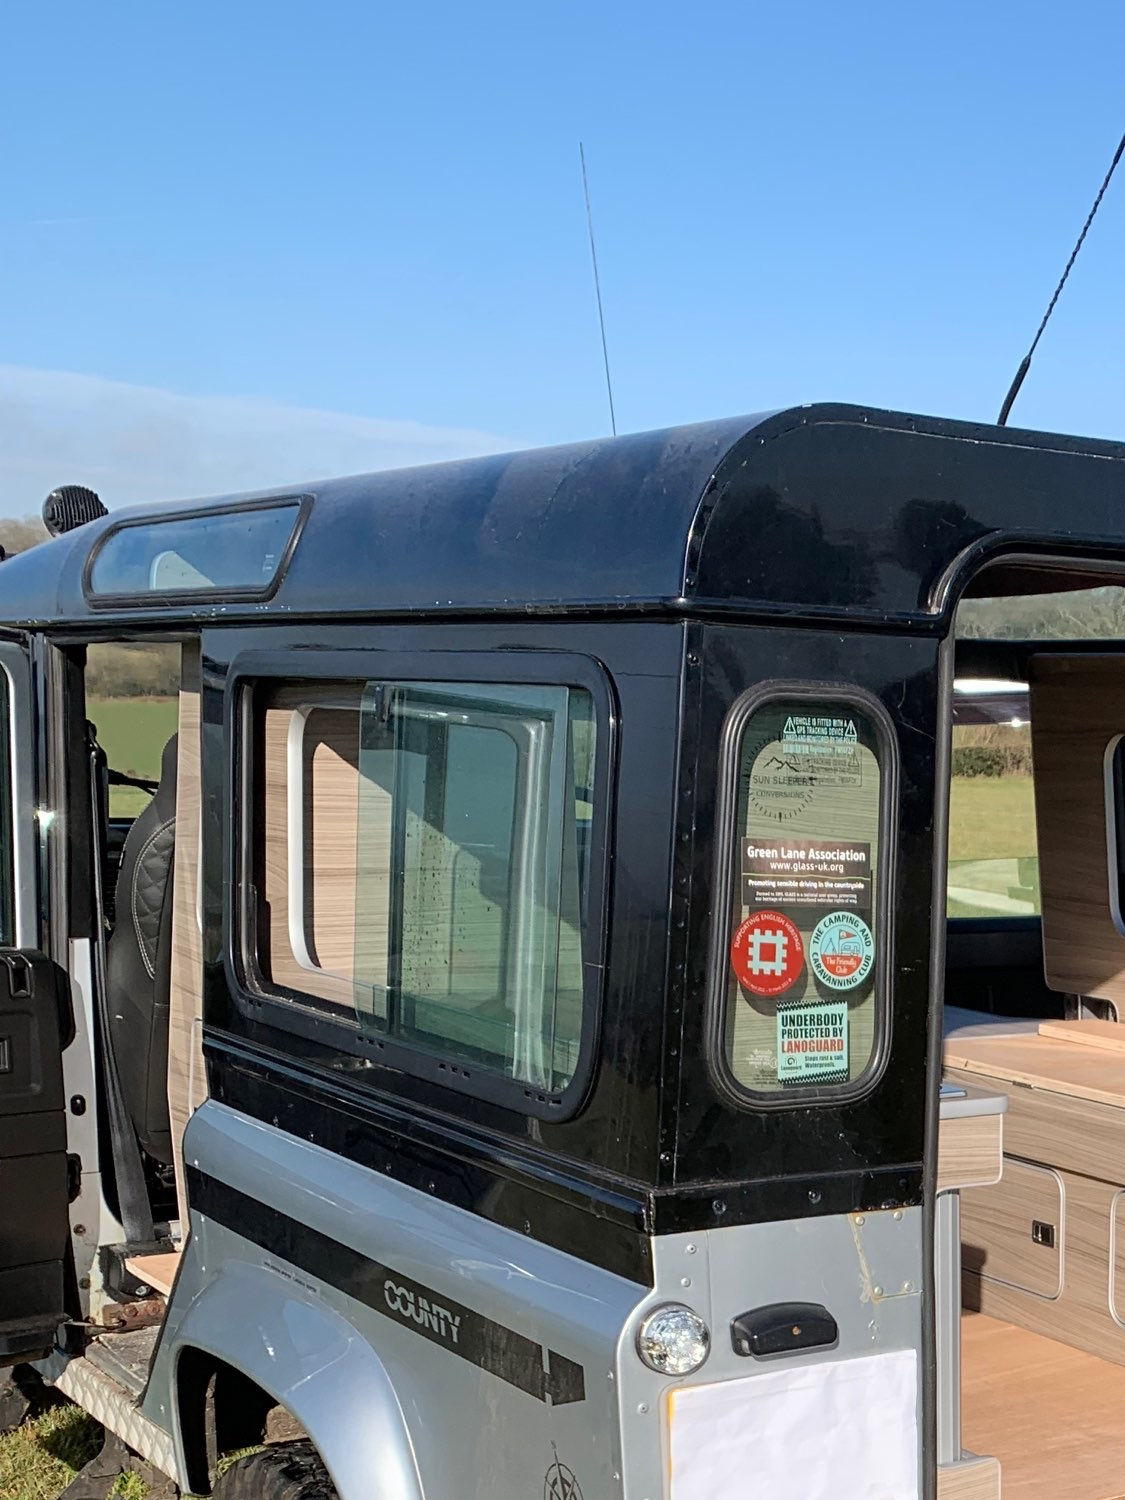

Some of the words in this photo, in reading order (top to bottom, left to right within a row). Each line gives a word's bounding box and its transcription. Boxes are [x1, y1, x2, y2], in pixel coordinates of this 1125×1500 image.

[807, 727, 828, 735] TRACKING
[829, 727, 844, 736] DEVICE
[753, 775, 770, 784] SUN
[772, 776, 809, 786] SLEEPER
[747, 845, 778, 859] Green
[781, 847, 805, 860] Lane
[808, 848, 866, 861] Association
[770, 861, 844, 873] www.glass-uk.org
[748, 879, 776, 888] Promoting
[799, 880, 817, 889] driving
[834, 882, 865, 890] countryside
[823, 914, 860, 928] CAMPING
[733, 915, 760, 948] SUPPORTING
[760, 913, 786, 925] ENGLISH
[784, 922, 802, 952] HERITAGE
[812, 928, 824, 945] THE
[859, 928, 872, 947] AND
[826, 957, 835, 965] The
[858, 954, 872, 976] CLUB
[812, 952, 858, 987] CARAVANNING
[781, 1013, 844, 1027] UNDERBODY
[781, 1027, 831, 1039] PROTECTED
[832, 1027, 844, 1037] BY
[781, 1039, 844, 1053] LANOGUARD
[384, 1280, 461, 1343] COUNTY
